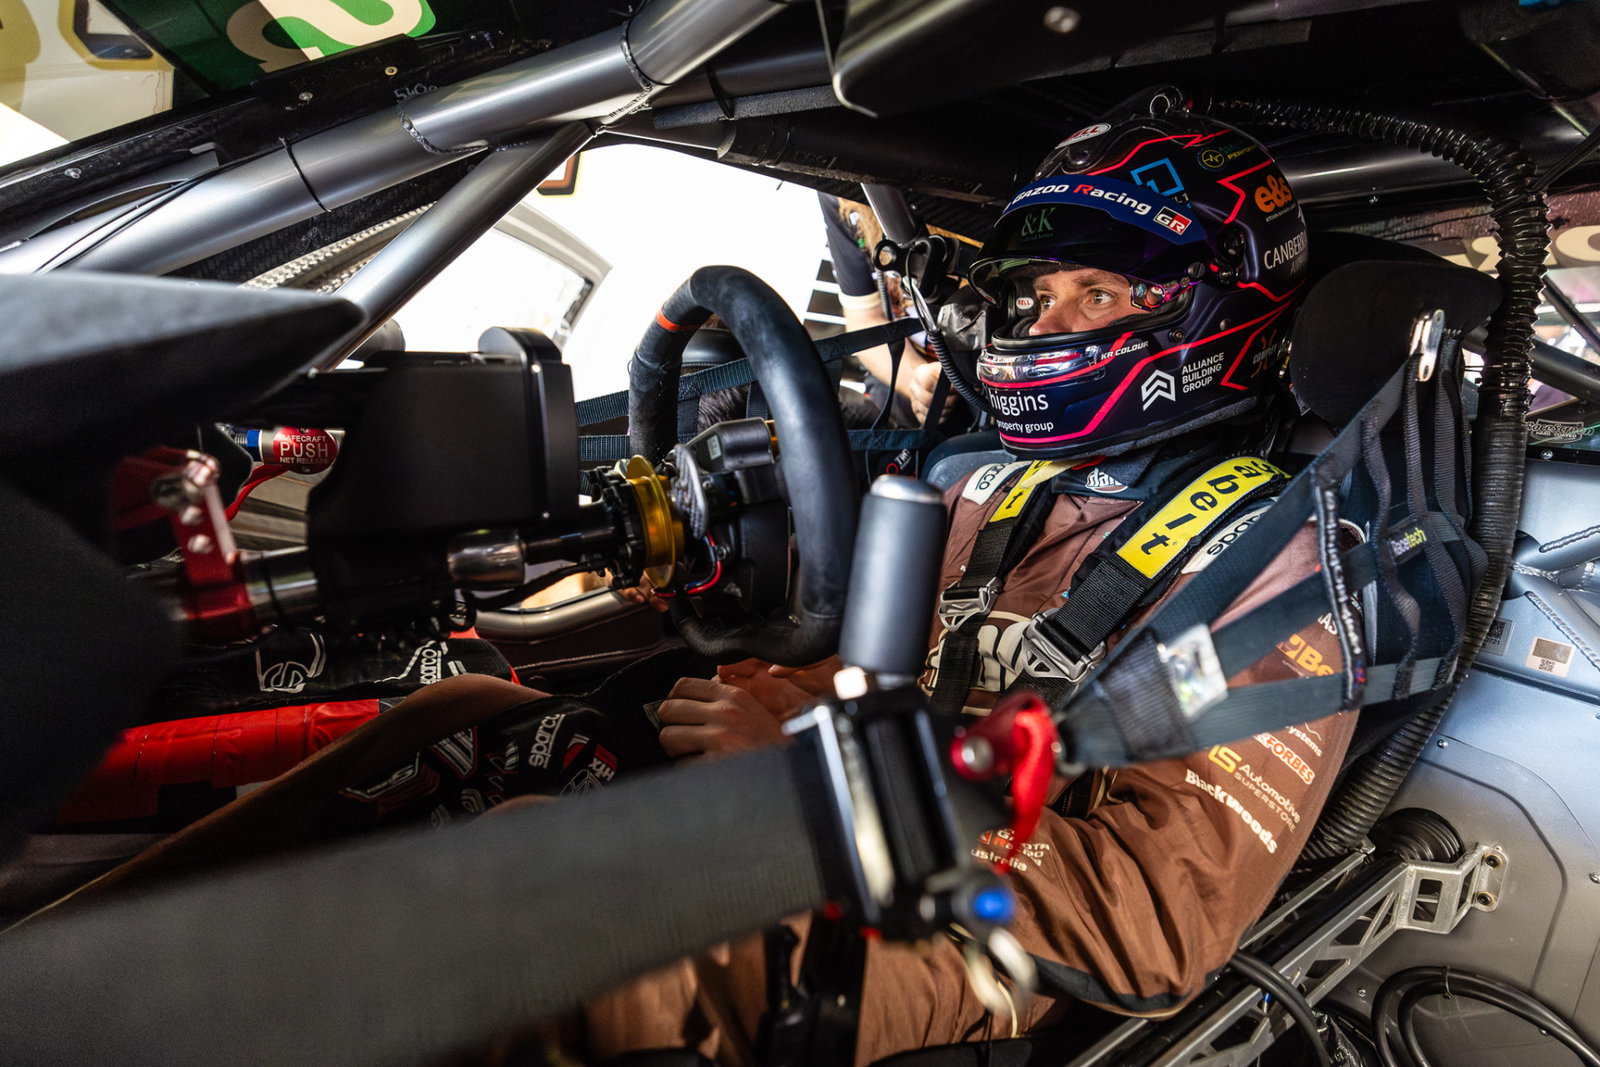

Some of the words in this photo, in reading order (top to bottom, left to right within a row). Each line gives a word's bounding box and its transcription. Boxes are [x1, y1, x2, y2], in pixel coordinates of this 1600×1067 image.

[1073, 184, 1152, 216] Racing
[1155, 213, 1188, 235] GR
[1101, 352, 1114, 360] KR
[1115, 341, 1149, 356] COLOUR
[1182, 352, 1225, 375] ALLIANCE
[1182, 363, 1222, 385] BUILDING
[1182, 376, 1213, 394] GROUP
[988, 388, 1049, 417] higgins
[1025, 421, 1054, 434] group
[280, 442, 329, 458] PUSH
[280, 456, 295, 464] NET
[1286, 724, 1323, 757] ystems
[1233, 771, 1296, 833] SUPERSTORE
[1238, 763, 1301, 824] Automotive
[1184, 768, 1278, 854] Blackwoods
[969, 847, 1028, 872] ustralia
